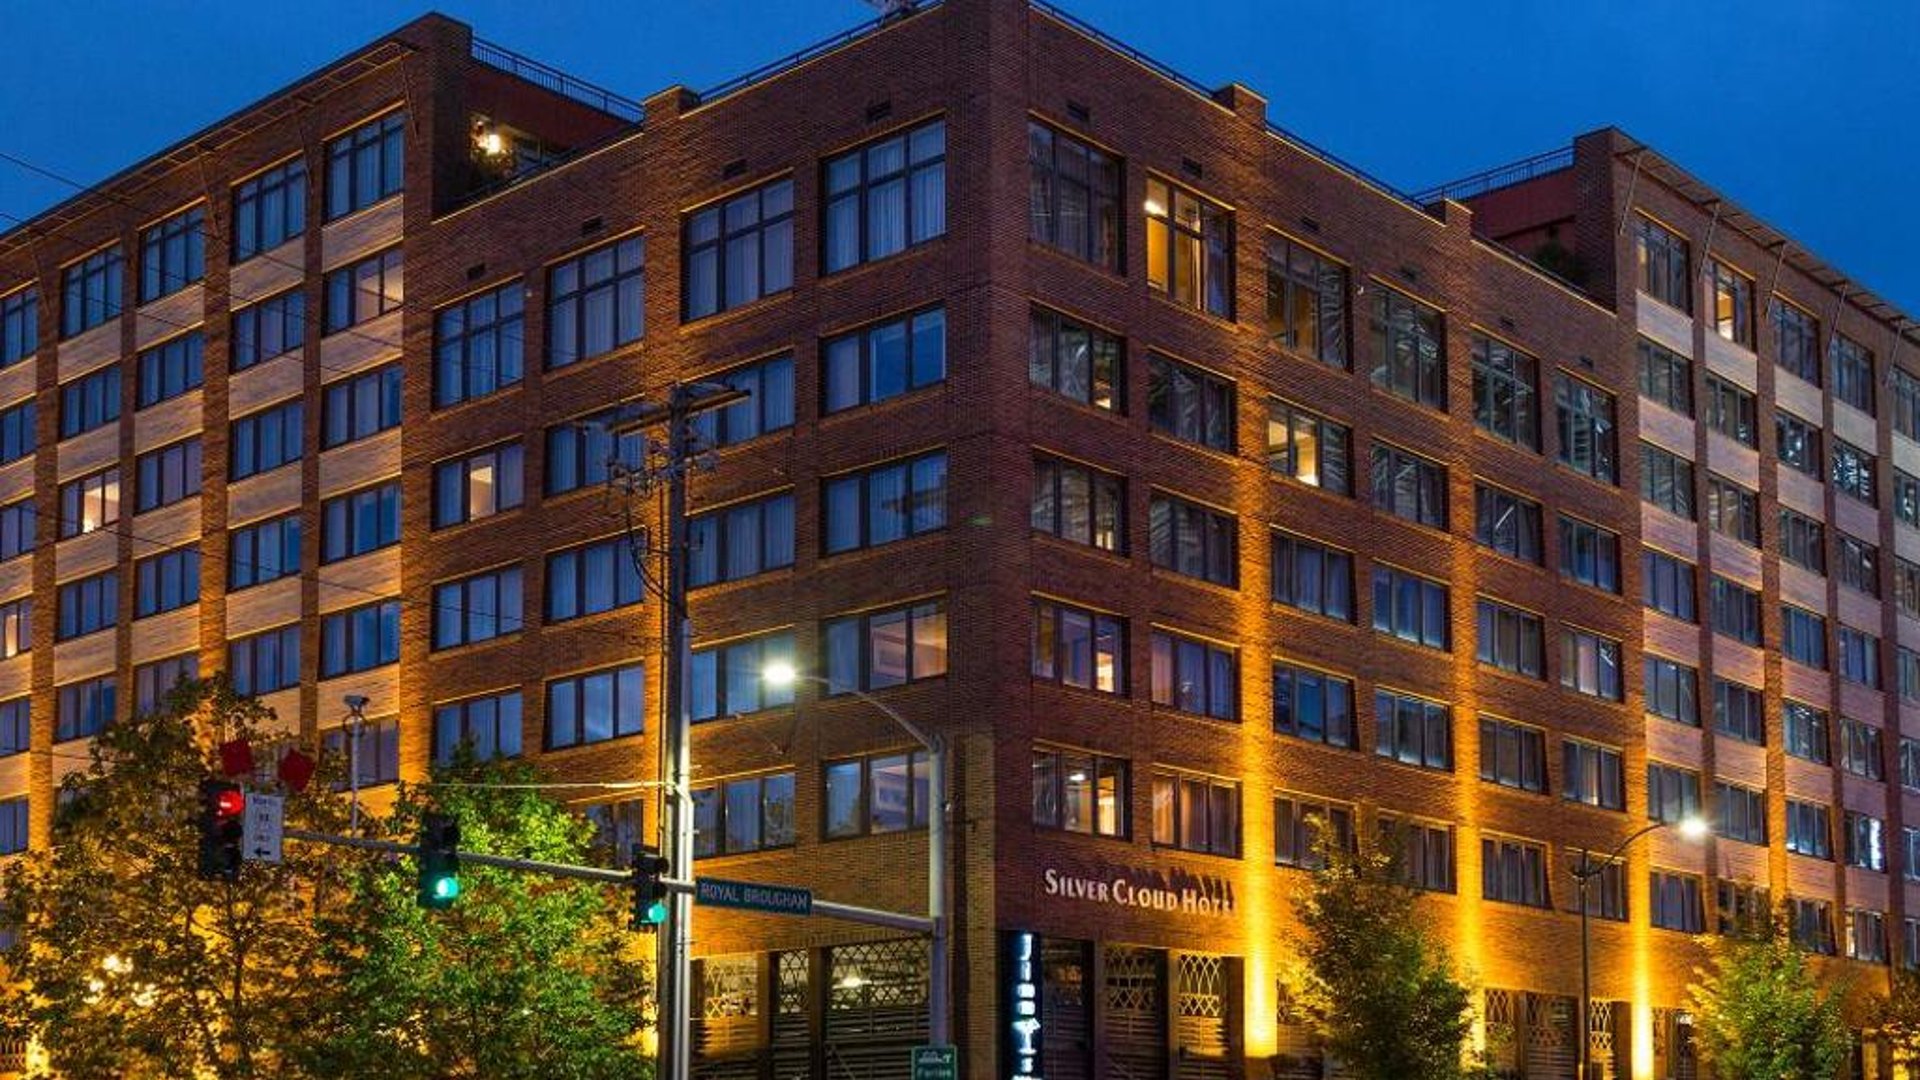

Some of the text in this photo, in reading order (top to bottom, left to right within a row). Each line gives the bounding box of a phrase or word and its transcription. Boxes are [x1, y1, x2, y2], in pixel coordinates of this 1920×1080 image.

[700, 881, 807, 908] ROYAL BROUGHAM
[1045, 868, 1108, 903] SILVER
[1113, 879, 1178, 912] CLOUD
